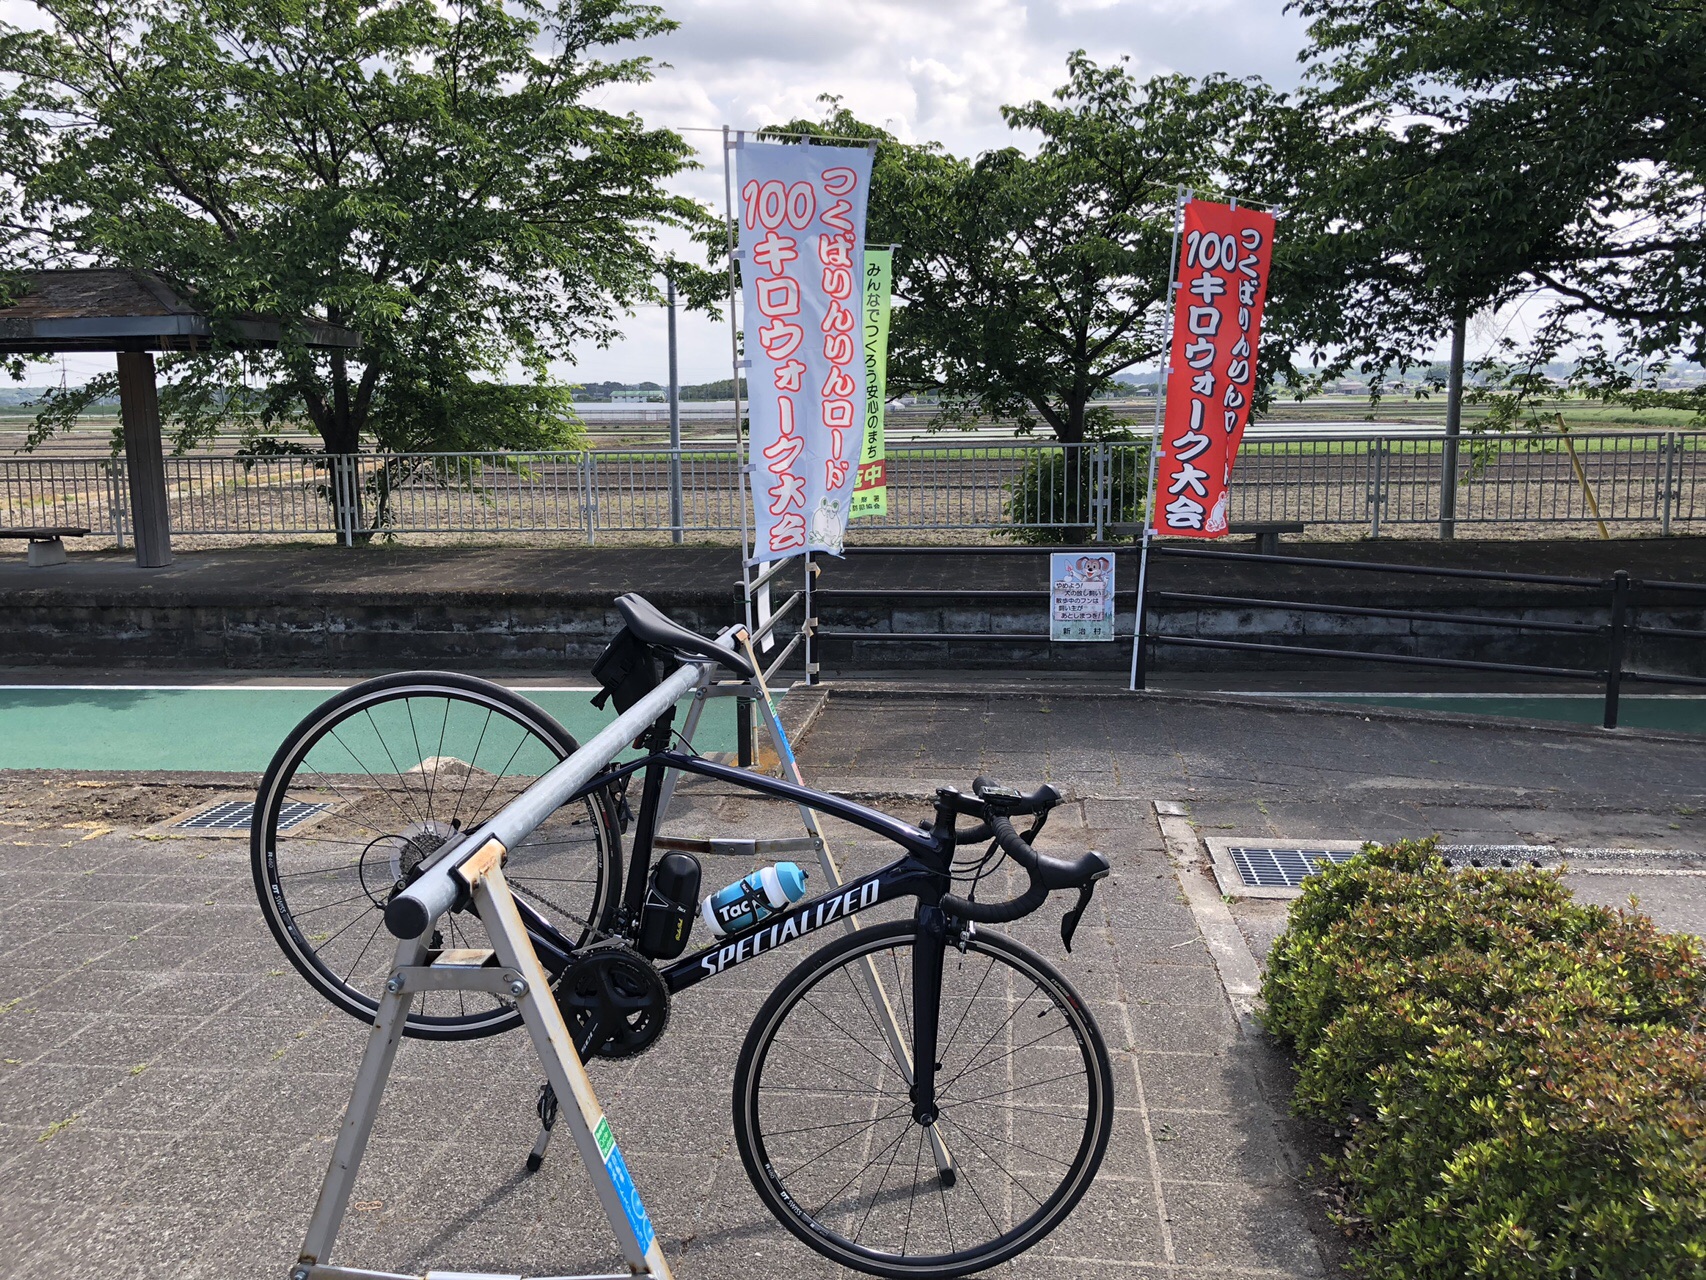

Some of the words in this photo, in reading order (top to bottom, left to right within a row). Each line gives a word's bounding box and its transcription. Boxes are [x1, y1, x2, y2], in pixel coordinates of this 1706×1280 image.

[743, 179, 816, 551] 100キロウォーク大会
[818, 167, 857, 491] つくばりんりんロード
[865, 263, 881, 459] みんなでつくろう安心のまち
[1166, 230, 1238, 529] 100キロウォーク大会
[701, 879, 879, 981] SPECIALIZED
